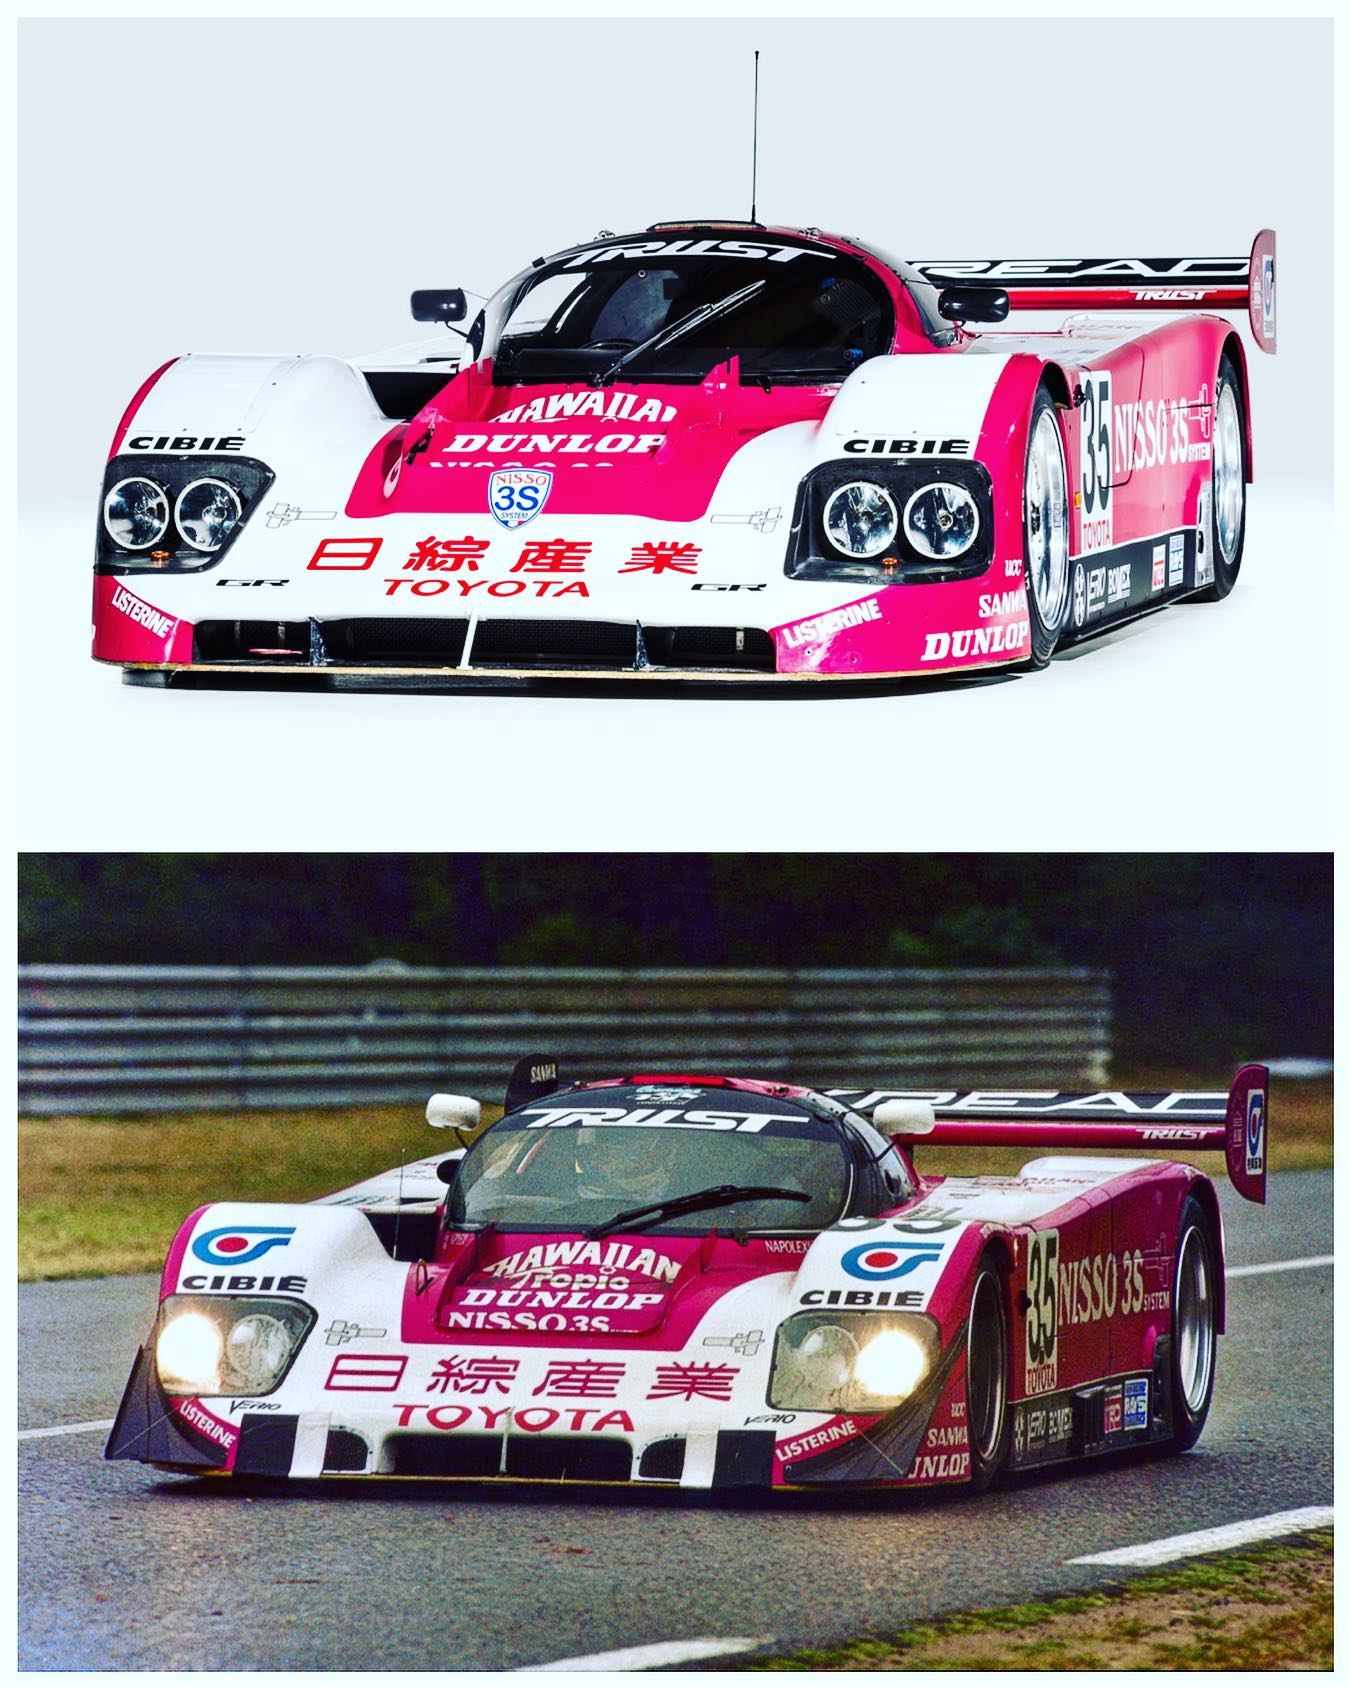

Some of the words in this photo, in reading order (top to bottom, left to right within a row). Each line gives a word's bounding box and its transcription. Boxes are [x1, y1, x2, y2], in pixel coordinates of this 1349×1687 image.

[563, 240, 837, 268] TRUST
[1130, 290, 1216, 301] TRUST
[442, 434, 666, 453] DUNLOP
[1083, 379, 1110, 514] 35
[1114, 400, 1168, 473] NISSO
[1170, 398, 1189, 464] 3S
[497, 473, 547, 486] NISSO
[495, 486, 540, 511] 3S
[500, 512, 529, 520] SYSTEM
[1083, 520, 1111, 550] TOYOTA
[1004, 559, 1022, 577] UCC
[216, 579, 290, 587] GR
[383, 579, 590, 598] TOYOTA
[690, 583, 767, 591] GR
[112, 586, 175, 639] LISTERINE
[979, 588, 1027, 618] SANWA
[782, 598, 883, 649] LISTERINE
[920, 620, 1029, 662] DUNLOP
[531, 1063, 556, 1084] SANWA
[521, 1107, 809, 1133] TRUST
[1136, 1129, 1218, 1140] TRUST
[482, 1241, 682, 1284] HAWAIIAN
[459, 1289, 664, 1310] DUNLOP
[1029, 1237, 1058, 1363] 35
[1058, 1252, 1118, 1326] NISSO
[1121, 1248, 1144, 1316] 3S
[1143, 1291, 1170, 1312] SYSTEM
[448, 1311, 567, 1331] NISSO
[1027, 1363, 1056, 1394] TOYOTA
[179, 1400, 237, 1449] LISTERINE
[393, 1405, 635, 1432] TOYOTA
[775, 1420, 858, 1462] LISTERINE
[926, 1426, 968, 1448] SANWA
